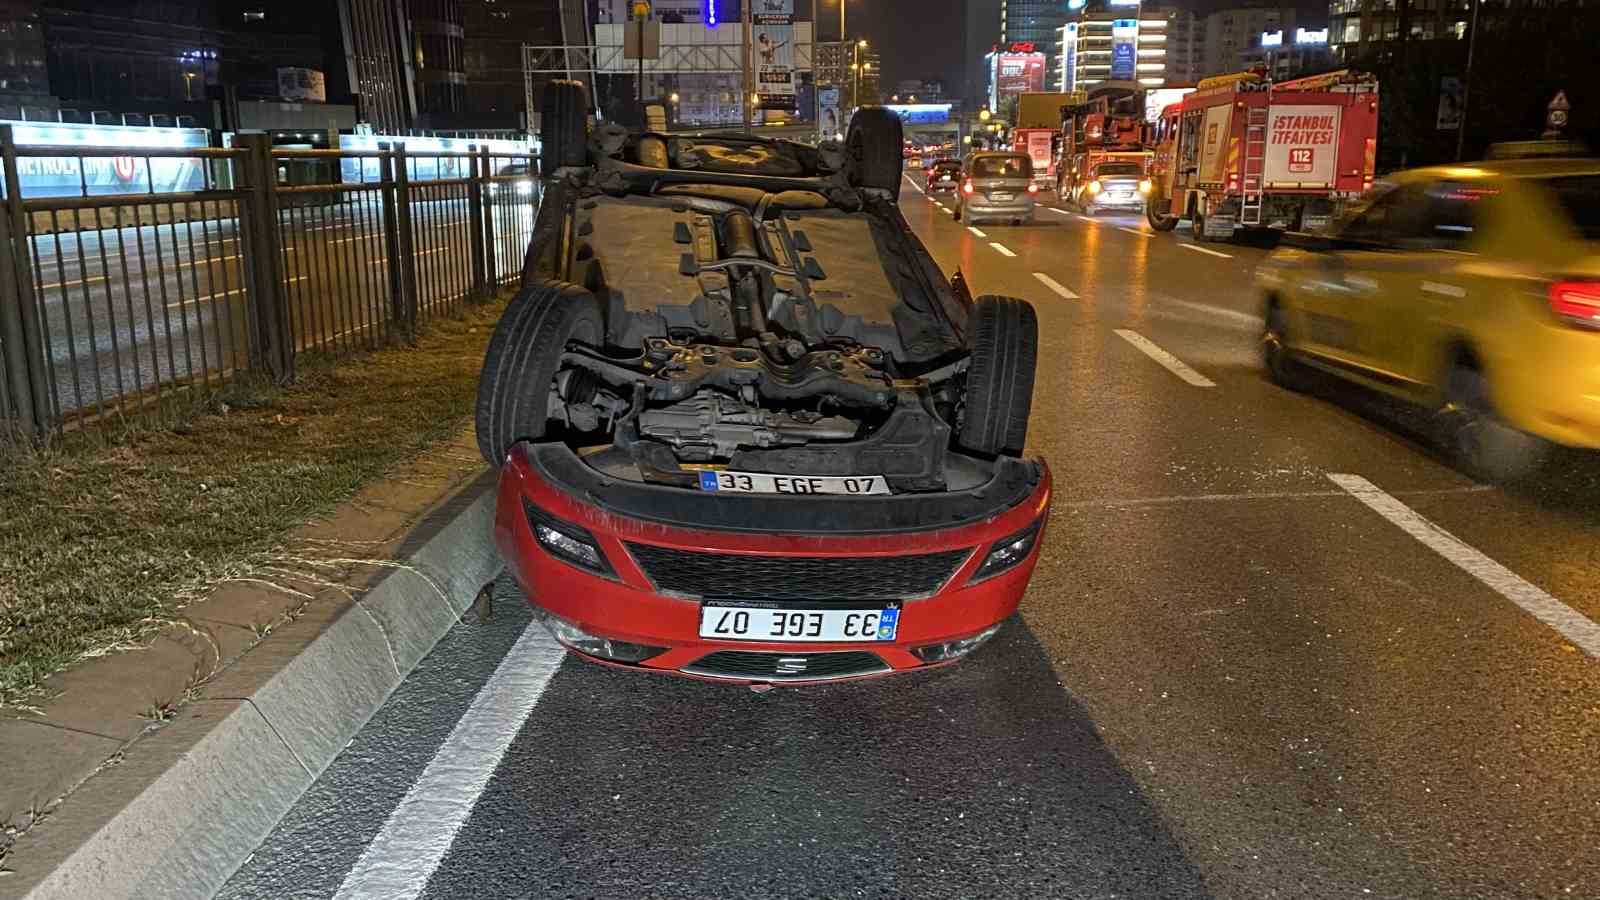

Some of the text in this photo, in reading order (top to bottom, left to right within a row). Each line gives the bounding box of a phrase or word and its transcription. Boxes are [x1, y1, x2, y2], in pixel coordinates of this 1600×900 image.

[1273, 115, 1334, 129] İSTANBUL
[1271, 131, 1333, 144] İTFAİYESİ
[1293, 150, 1311, 162] 112
[719, 473, 753, 490] 33
[774, 477, 823, 494] EGE
[844, 478, 874, 492] 07
[714, 611, 893, 637] TR 33 EGE 07
